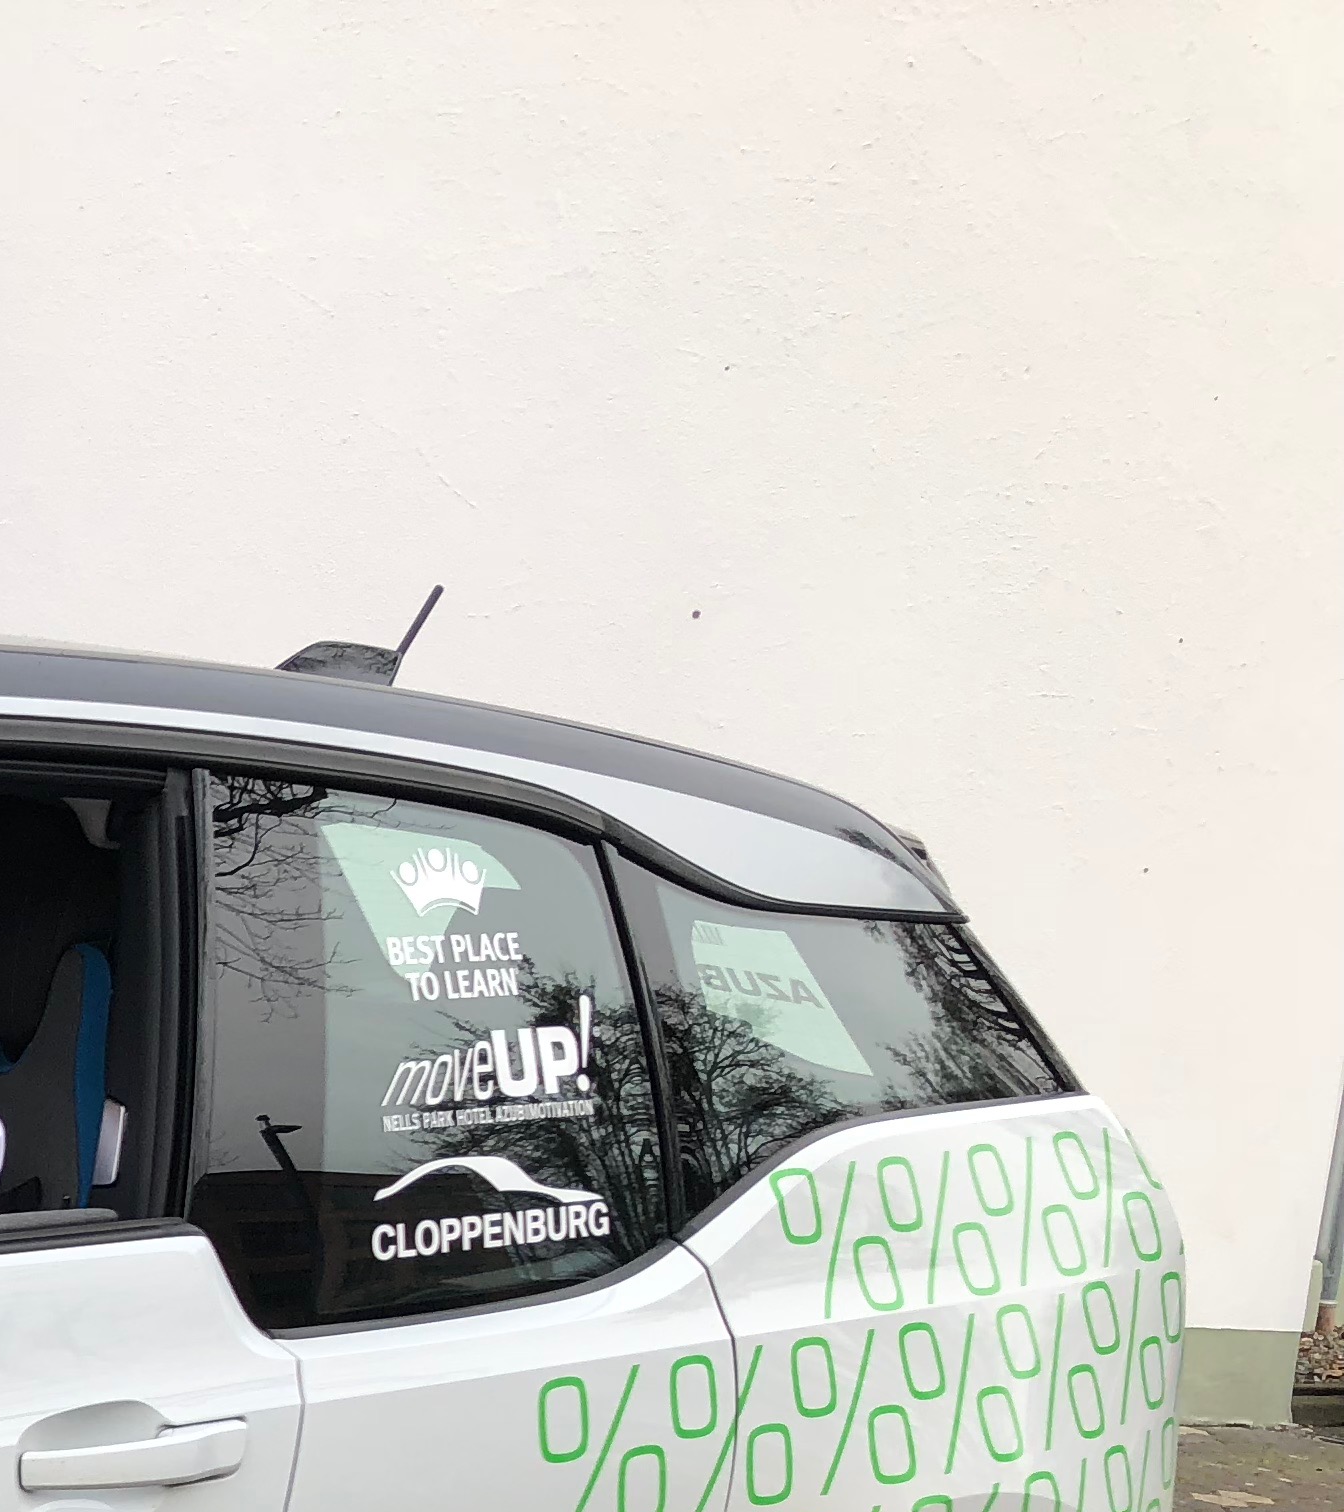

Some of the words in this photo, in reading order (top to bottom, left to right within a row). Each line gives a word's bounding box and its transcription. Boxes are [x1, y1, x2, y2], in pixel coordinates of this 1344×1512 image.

[386, 934, 445, 966] BEST
[450, 932, 523, 963] PLACE
[404, 971, 440, 1001] TO
[443, 967, 520, 1000] LEARN
[382, 1113, 421, 1133] NELLS
[423, 1109, 455, 1130] PARK
[456, 1107, 493, 1126] HOTEL
[371, 1201, 610, 1261] CLOPPENBURG
